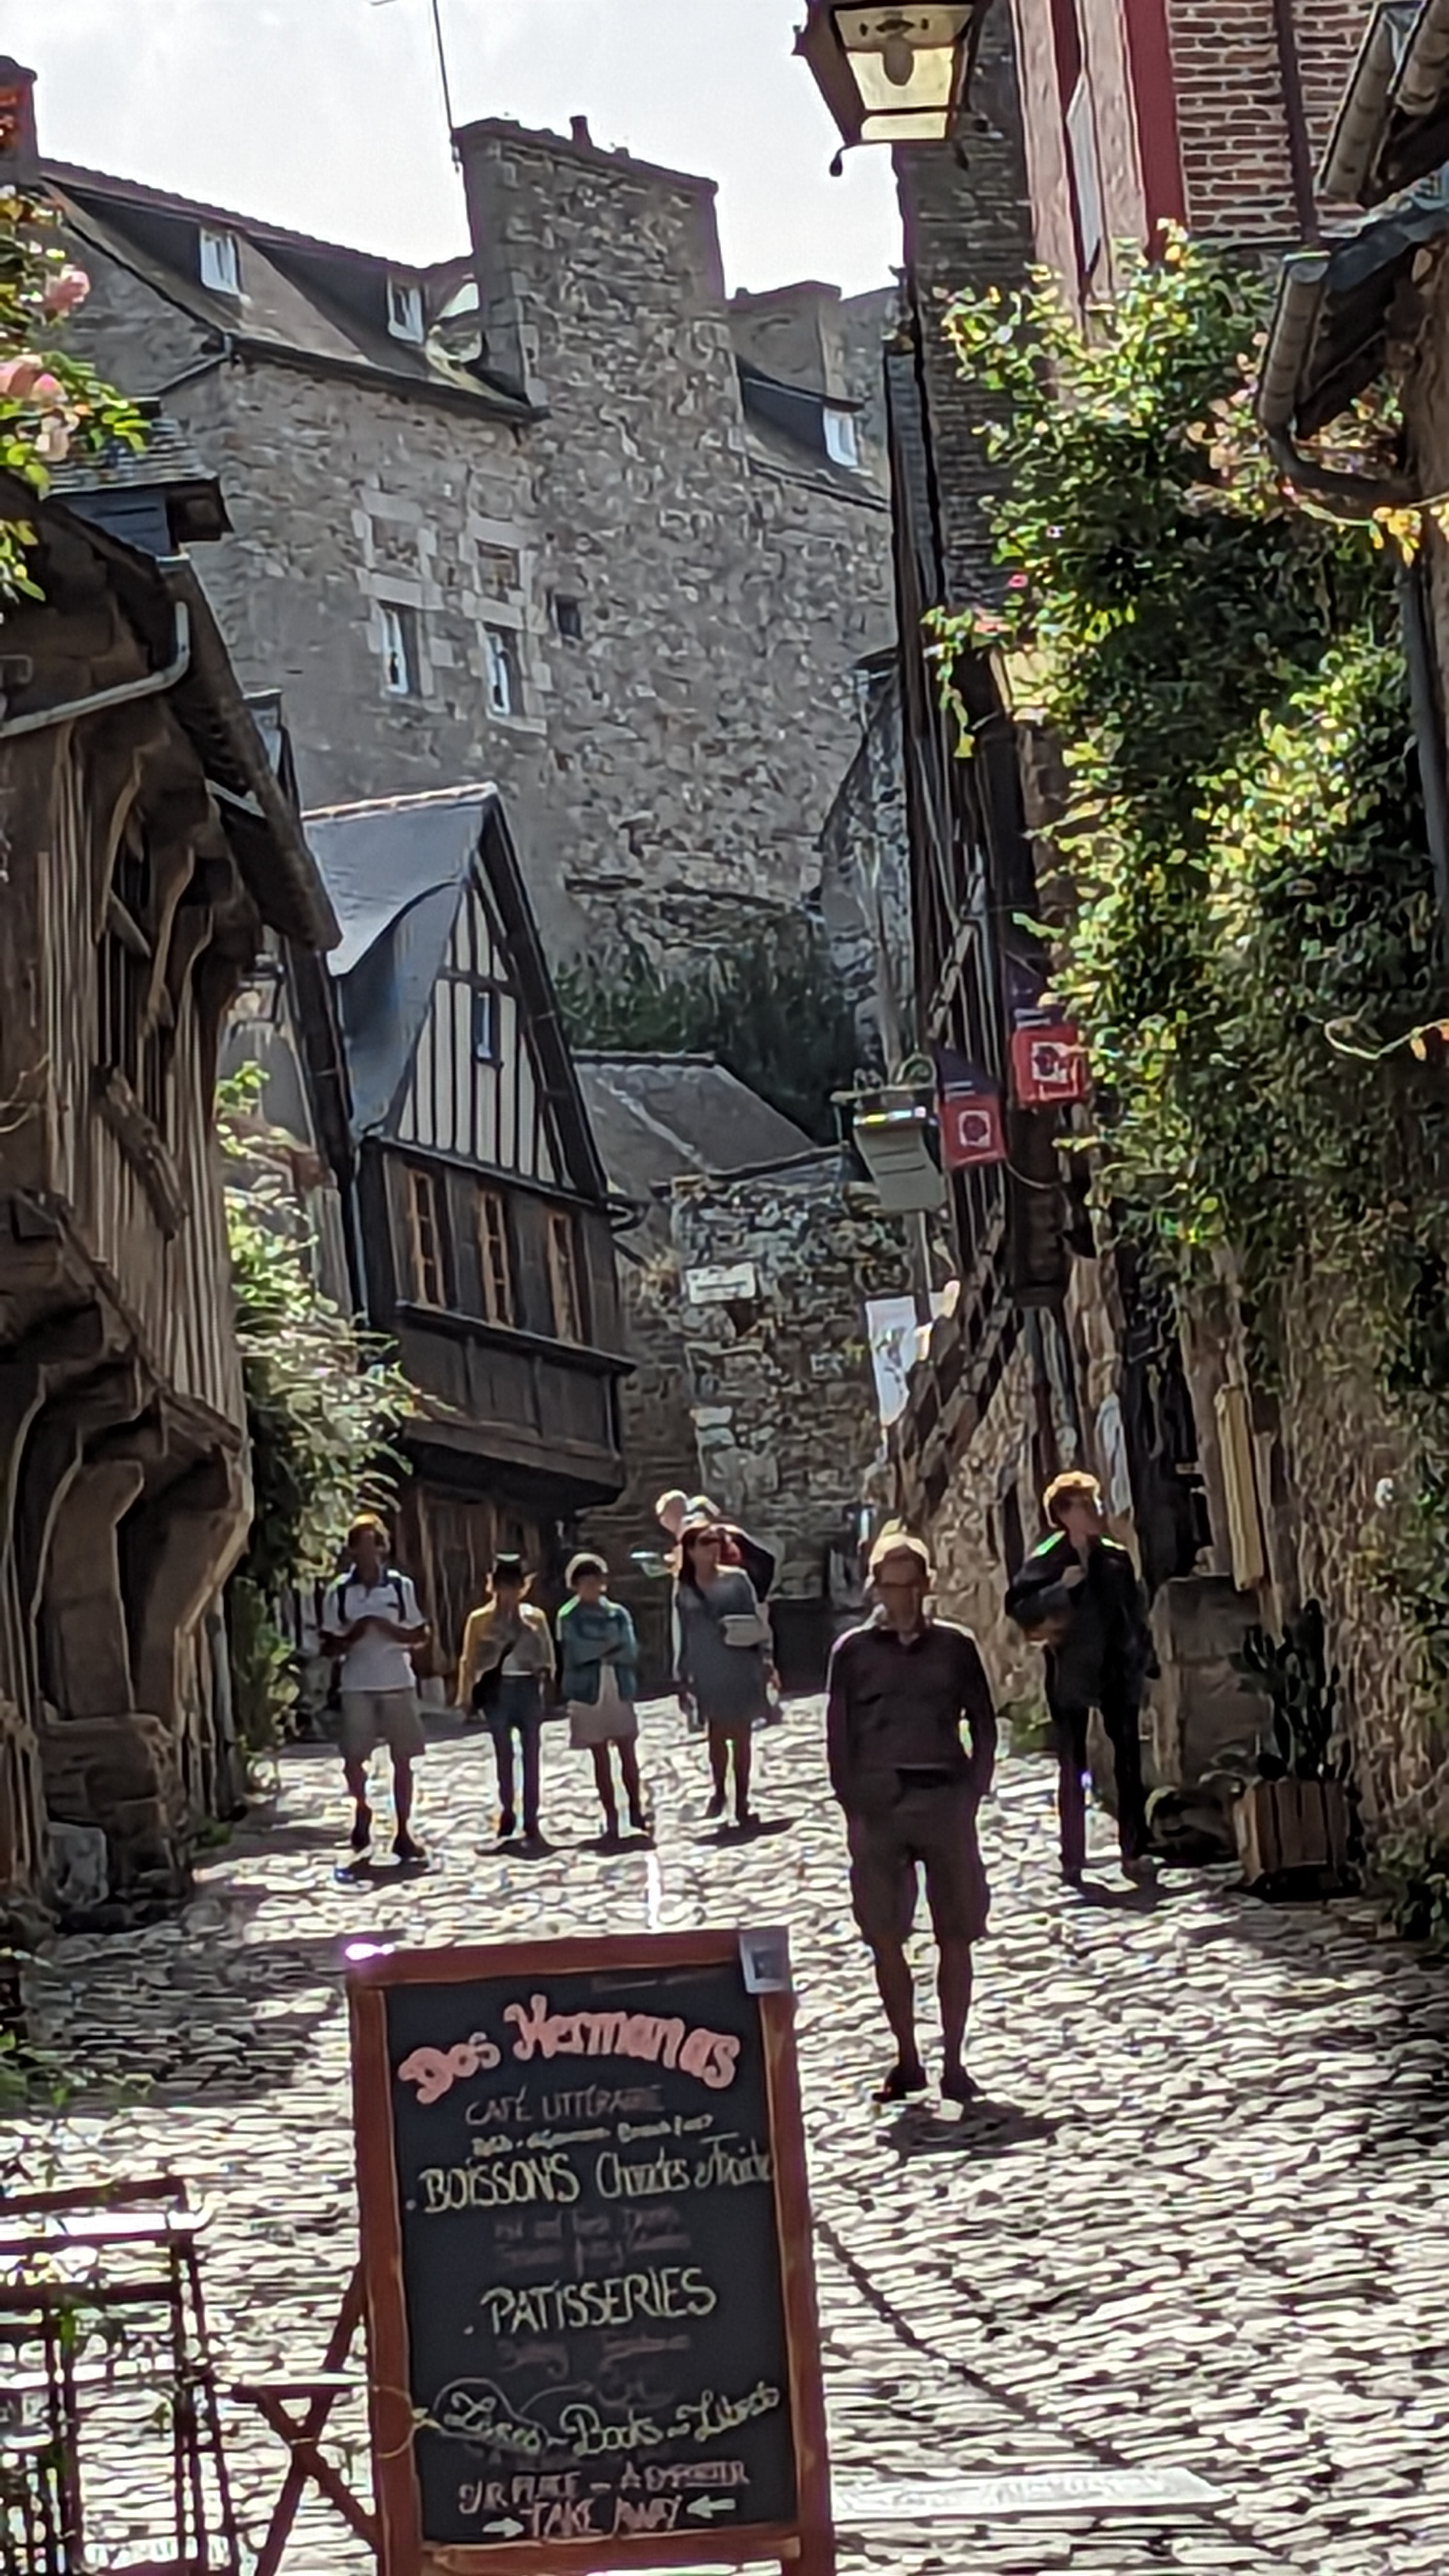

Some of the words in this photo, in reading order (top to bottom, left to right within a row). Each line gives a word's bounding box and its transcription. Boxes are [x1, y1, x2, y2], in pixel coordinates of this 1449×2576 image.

[397, 2032, 501, 2104] Dos
[503, 1993, 741, 2089] Hermanas
[542, 2083, 666, 2121] LITTÉRAE
[519, 2500, 602, 2539] TAKE
